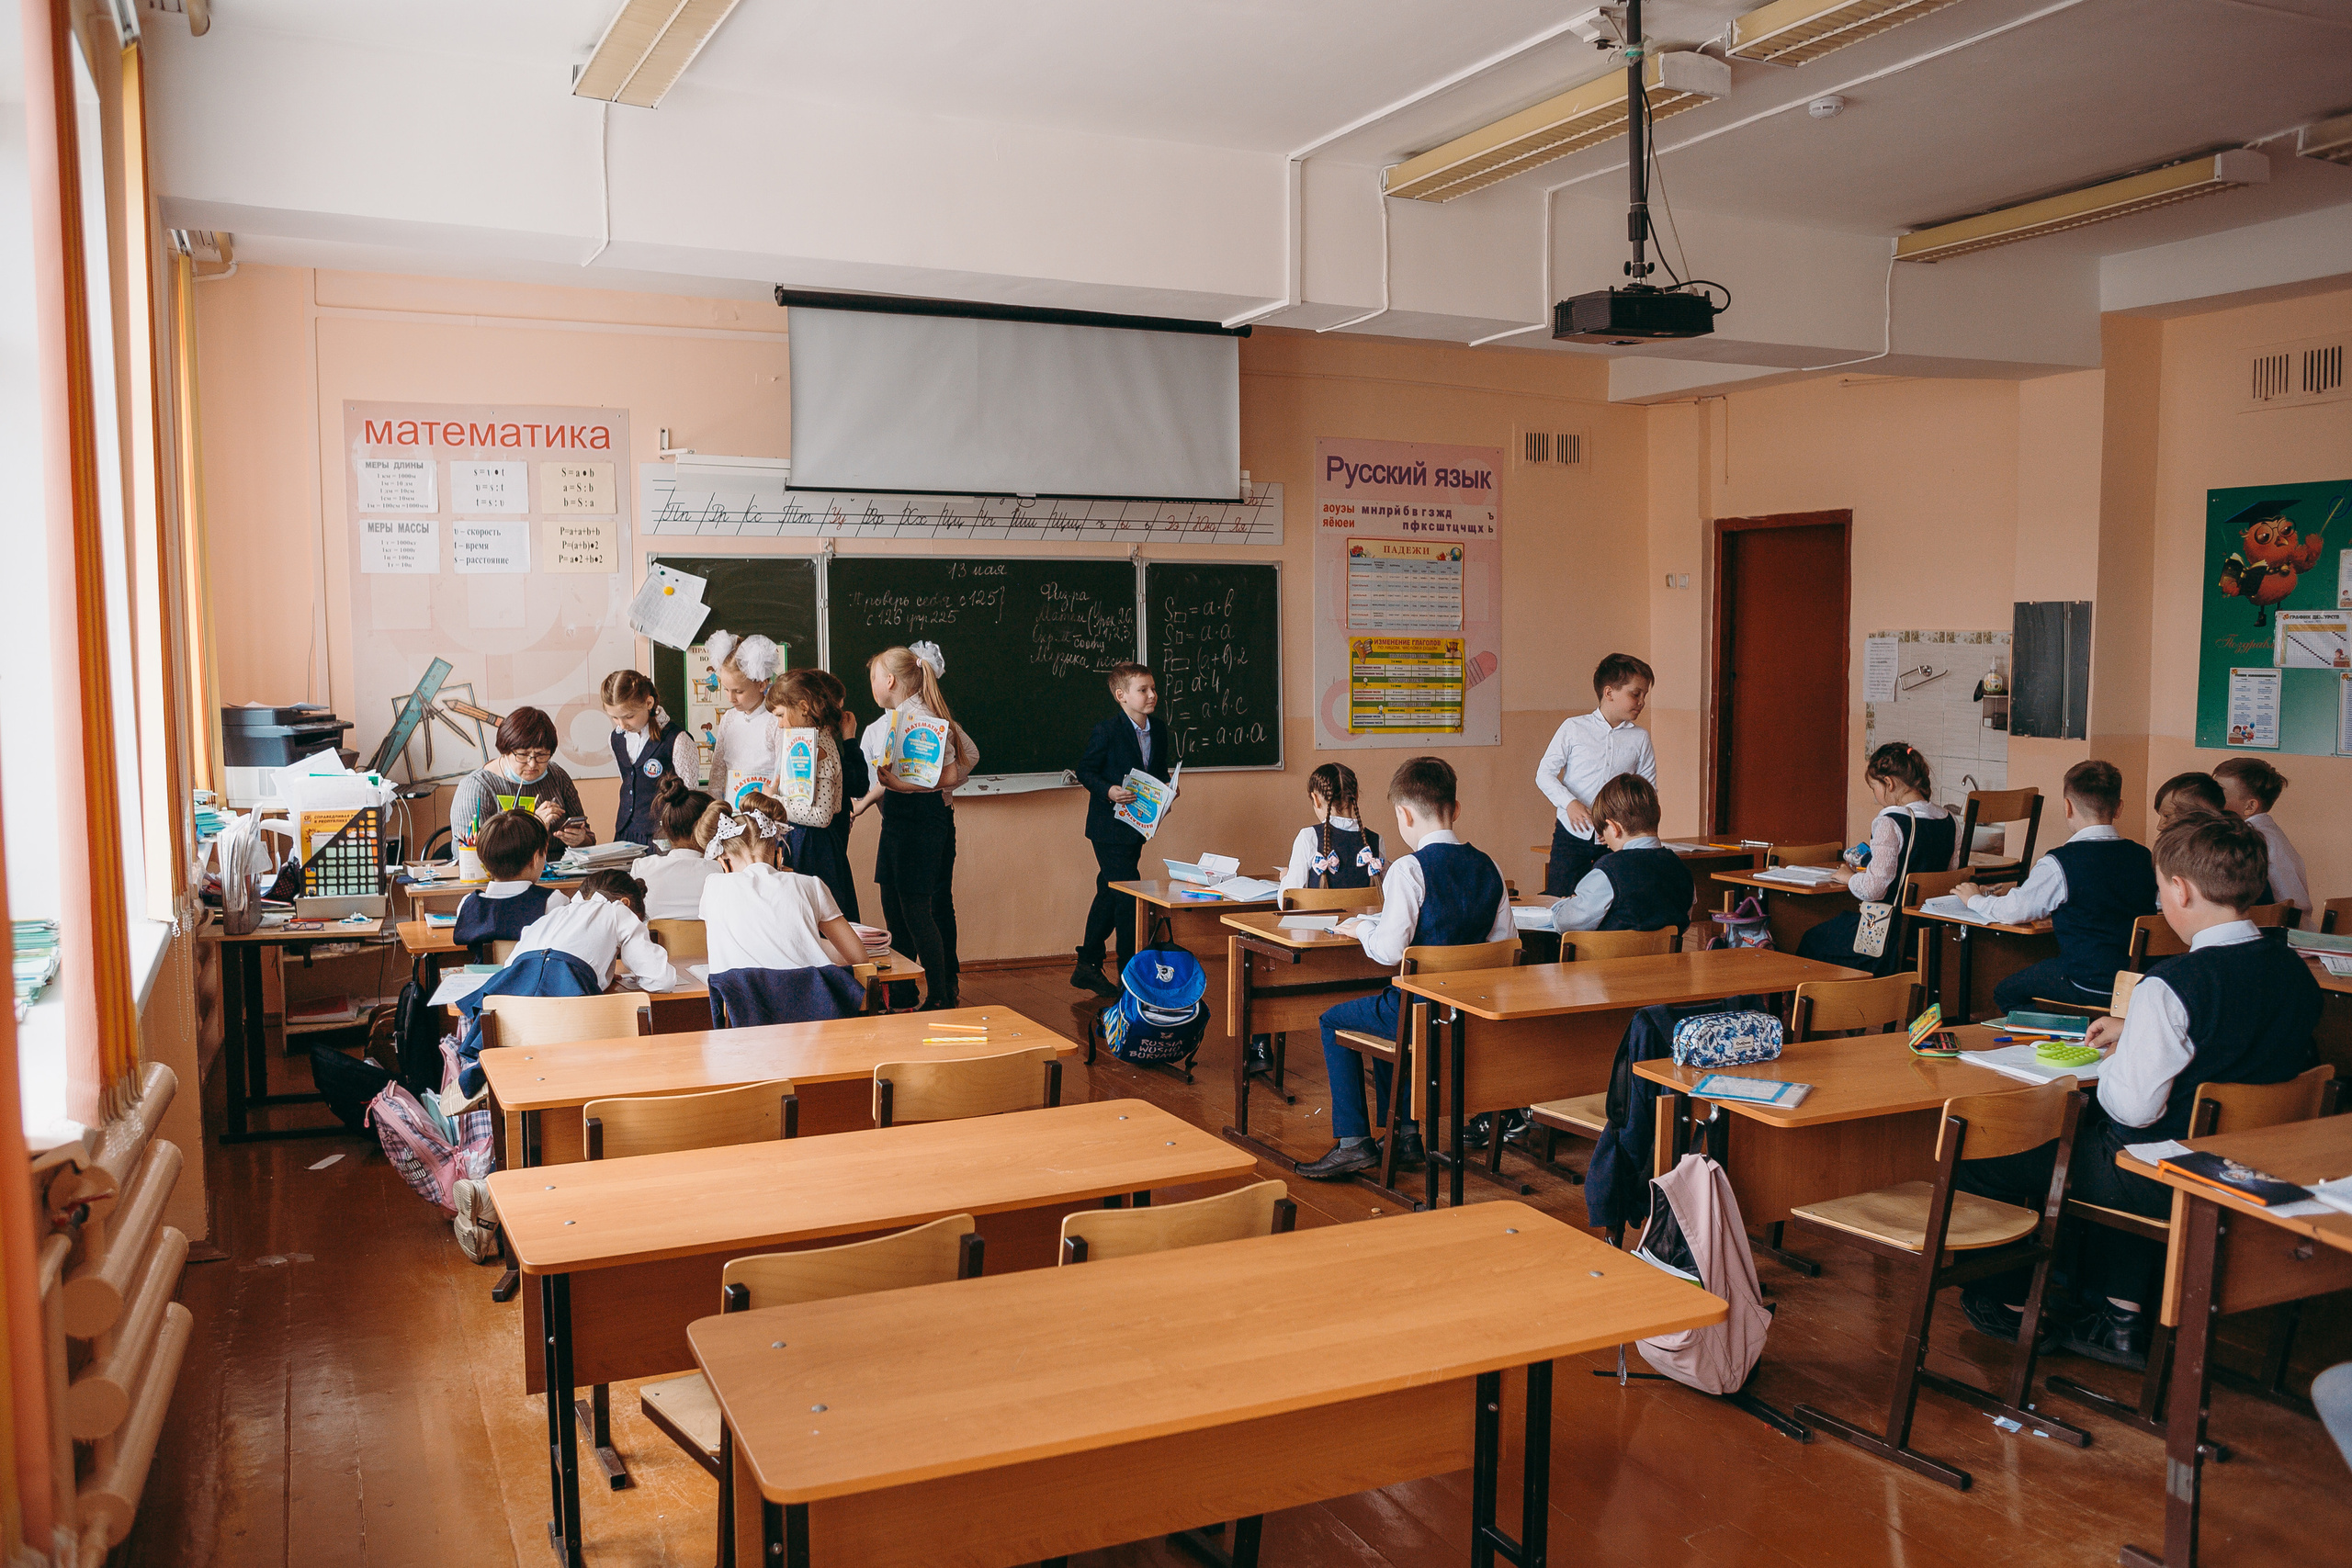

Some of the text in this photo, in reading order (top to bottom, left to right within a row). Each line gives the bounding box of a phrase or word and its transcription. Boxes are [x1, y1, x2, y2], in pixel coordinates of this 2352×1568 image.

[590, 468, 594, 477] b
[1327, 456, 1492, 489] Русский язык
[589, 483, 594, 491] b
[564, 498, 568, 507] b
[1323, 503, 1354, 515] аоуэы
[1322, 518, 1354, 527] яёюеи
[368, 523, 429, 533] МЕРЫ МАССЫ
[467, 528, 501, 538] скорость
[465, 542, 489, 551] время
[1384, 546, 1430, 555] ПАДЕЖИ
[466, 557, 509, 566] расстояние
[948, 562, 1007, 579] 13 мая
[734, 776, 772, 792] МАТЕМАТИ
[1141, 1039, 1182, 1047] RUSSIA
